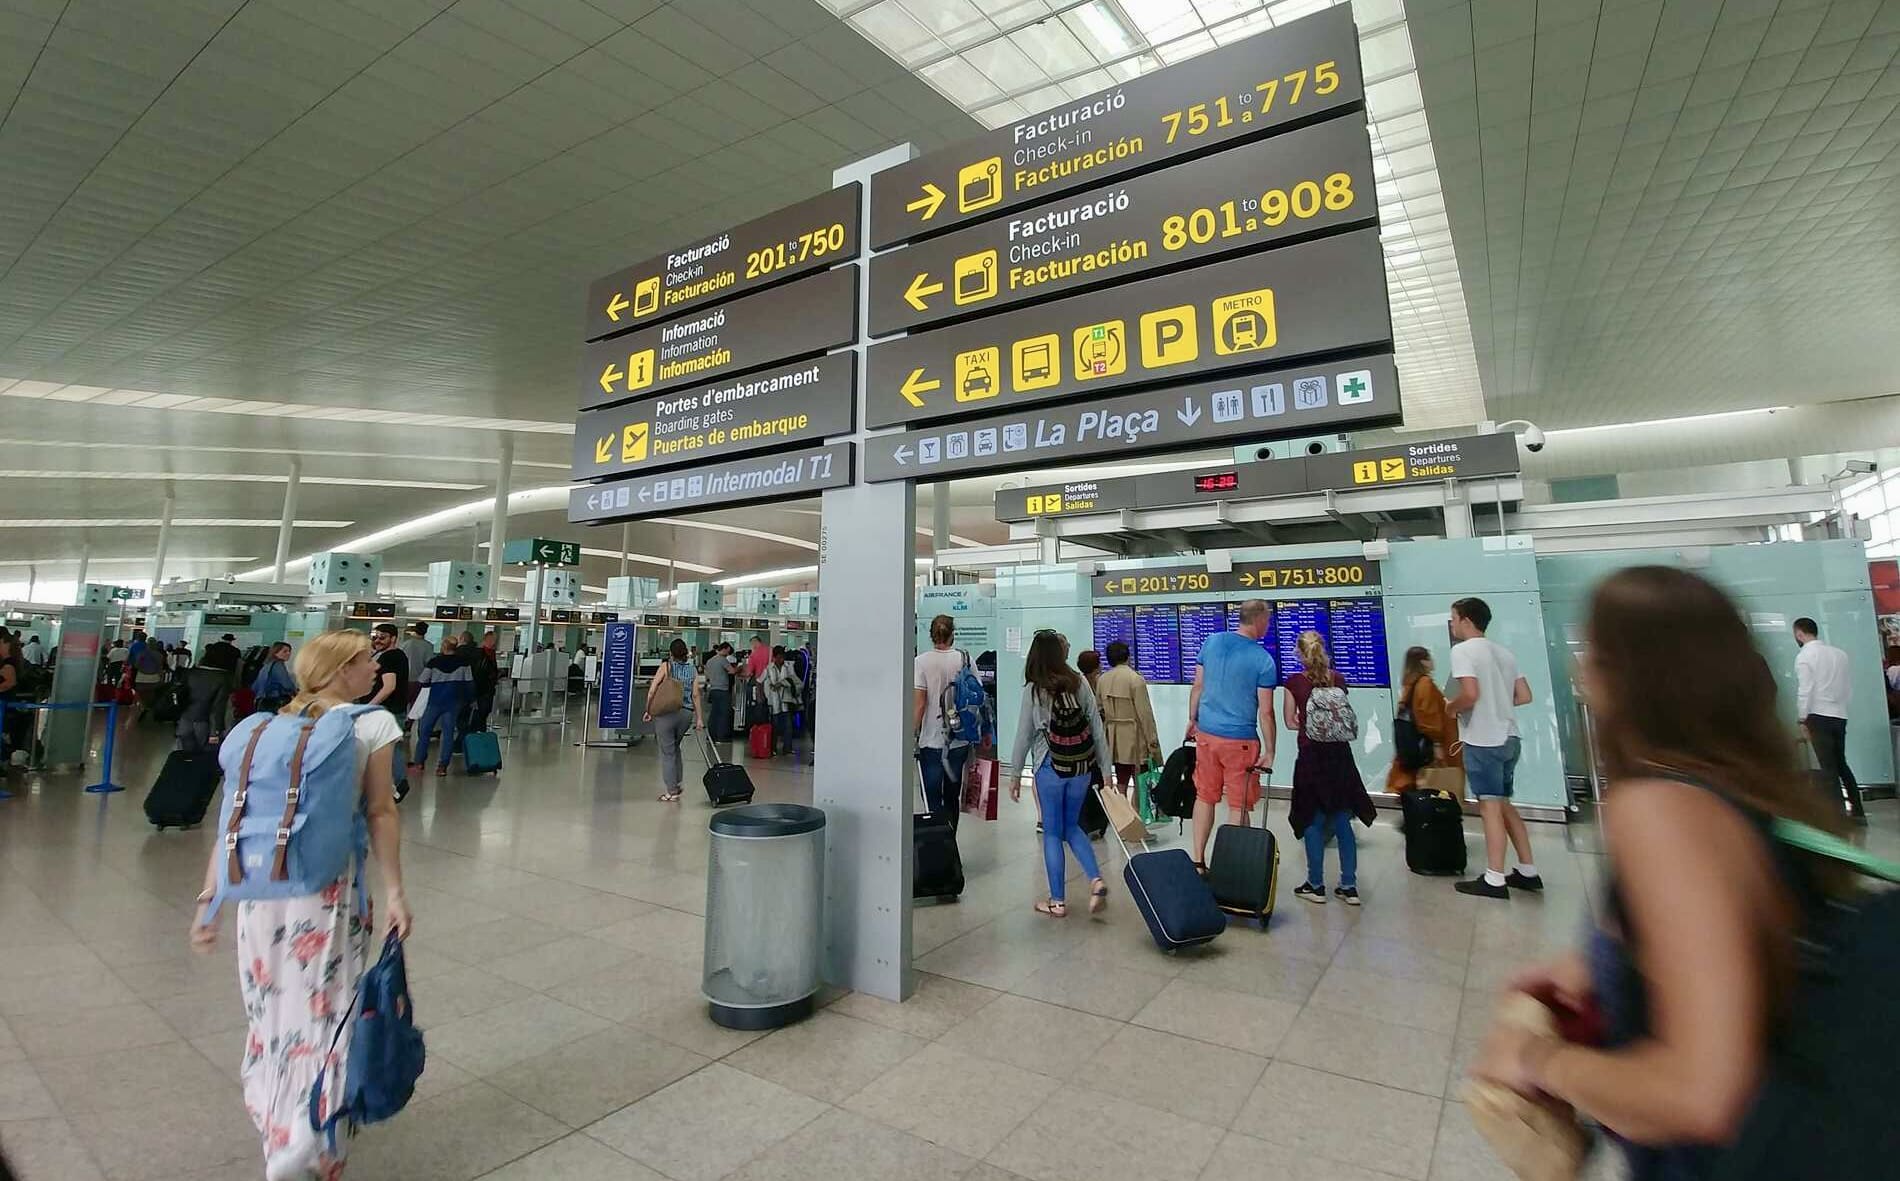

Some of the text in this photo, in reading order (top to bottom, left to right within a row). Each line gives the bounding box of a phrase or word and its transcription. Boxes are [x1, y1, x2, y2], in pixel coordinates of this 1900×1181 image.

[1013, 91, 1127, 145] Facturació
[1161, 60, 1340, 145] 751 to a 775
[1013, 127, 1093, 166] Check-in
[1015, 134, 1144, 192] Facturación
[1009, 190, 1130, 242] Facturació
[1162, 171, 1355, 252] 801 to a 908
[667, 234, 730, 270] Facturació
[746, 243, 787, 280] 201
[789, 240, 797, 251] to
[798, 223, 845, 262] 750
[1010, 232, 1081, 264] Check-in
[666, 263, 704, 287] Check-in
[1010, 238, 1149, 291] Facturación
[664, 270, 735, 306] Facturación
[1222, 295, 1263, 312] METRO
[662, 309, 725, 343] Informació
[1093, 327, 1105, 340] T1
[1156, 318, 1184, 358] P
[661, 333, 718, 360] Information
[963, 351, 991, 367] TAXI
[659, 348, 731, 380] Información
[1093, 361, 1107, 373] T2
[656, 366, 820, 417] Portes d'embarcament
[653, 413, 808, 456] Puertas de embarque
[655, 408, 734, 436] Boarding gates
[1034, 406, 1160, 447] La Plaça
[1409, 442, 1458, 456] Sortides
[1410, 452, 1461, 466] Departures
[705, 453, 833, 496] Intermodal T1
[1411, 464, 1454, 477] Salidas
[1064, 482, 1097, 494] Sortides
[1064, 490, 1099, 502] Departures
[1064, 500, 1094, 511] Salidas
[1139, 576, 1170, 592] 201
[1177, 573, 1210, 591] 750
[1280, 568, 1316, 586] 751
[1325, 566, 1363, 584] 800
